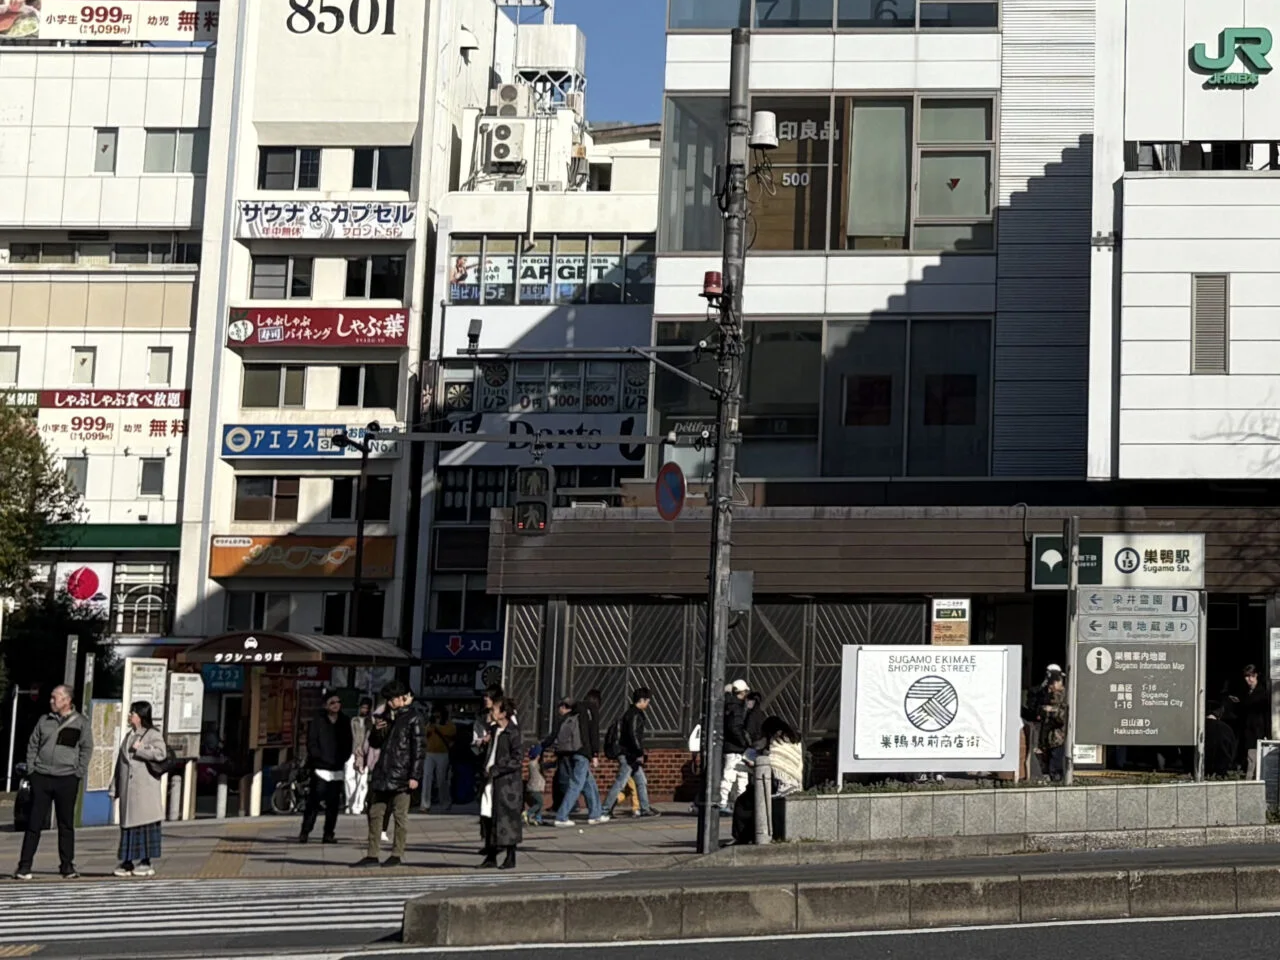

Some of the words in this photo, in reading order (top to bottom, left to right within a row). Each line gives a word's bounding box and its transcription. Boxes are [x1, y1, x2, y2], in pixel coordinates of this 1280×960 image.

[46, 14, 78, 25] 小学生
[80, 5, 133, 25] 999円
[1192, 27, 1273, 71] JR
[778, 119, 840, 141] 印良品
[782, 172, 810, 187] 500
[507, 265, 609, 280] TARGET
[257, 313, 311, 327] しゃぶしゃぶ
[336, 312, 406, 339] しゃぶ葉
[55, 392, 181, 407] しゃぶしゃぶ食べ放題
[71, 416, 114, 432] 999円
[253, 429, 315, 449] アエラス
[1143, 549, 1190, 564] 巣鴨駅
[1122, 560, 1133, 569] 15
[1143, 564, 1175, 573] Sugamo
[1176, 564, 1192, 572] Sta.
[1108, 621, 1188, 632] 巣鴨地蔵通り
[468, 639, 492, 652] 入口
[214, 652, 283, 662] タクシーのりば
[888, 655, 932, 664] SUGAMO
[935, 655, 977, 664] EKIMAE
[888, 664, 937, 673] SHOPPING
[941, 664, 977, 673] STREET
[1114, 662, 1138, 671] Sugamo
[1172, 662, 1185, 671] Map
[1114, 701, 1133, 709] 1-16
[1170, 700, 1184, 708] City
[880, 734, 980, 749] 巣鴨駅前商店街
